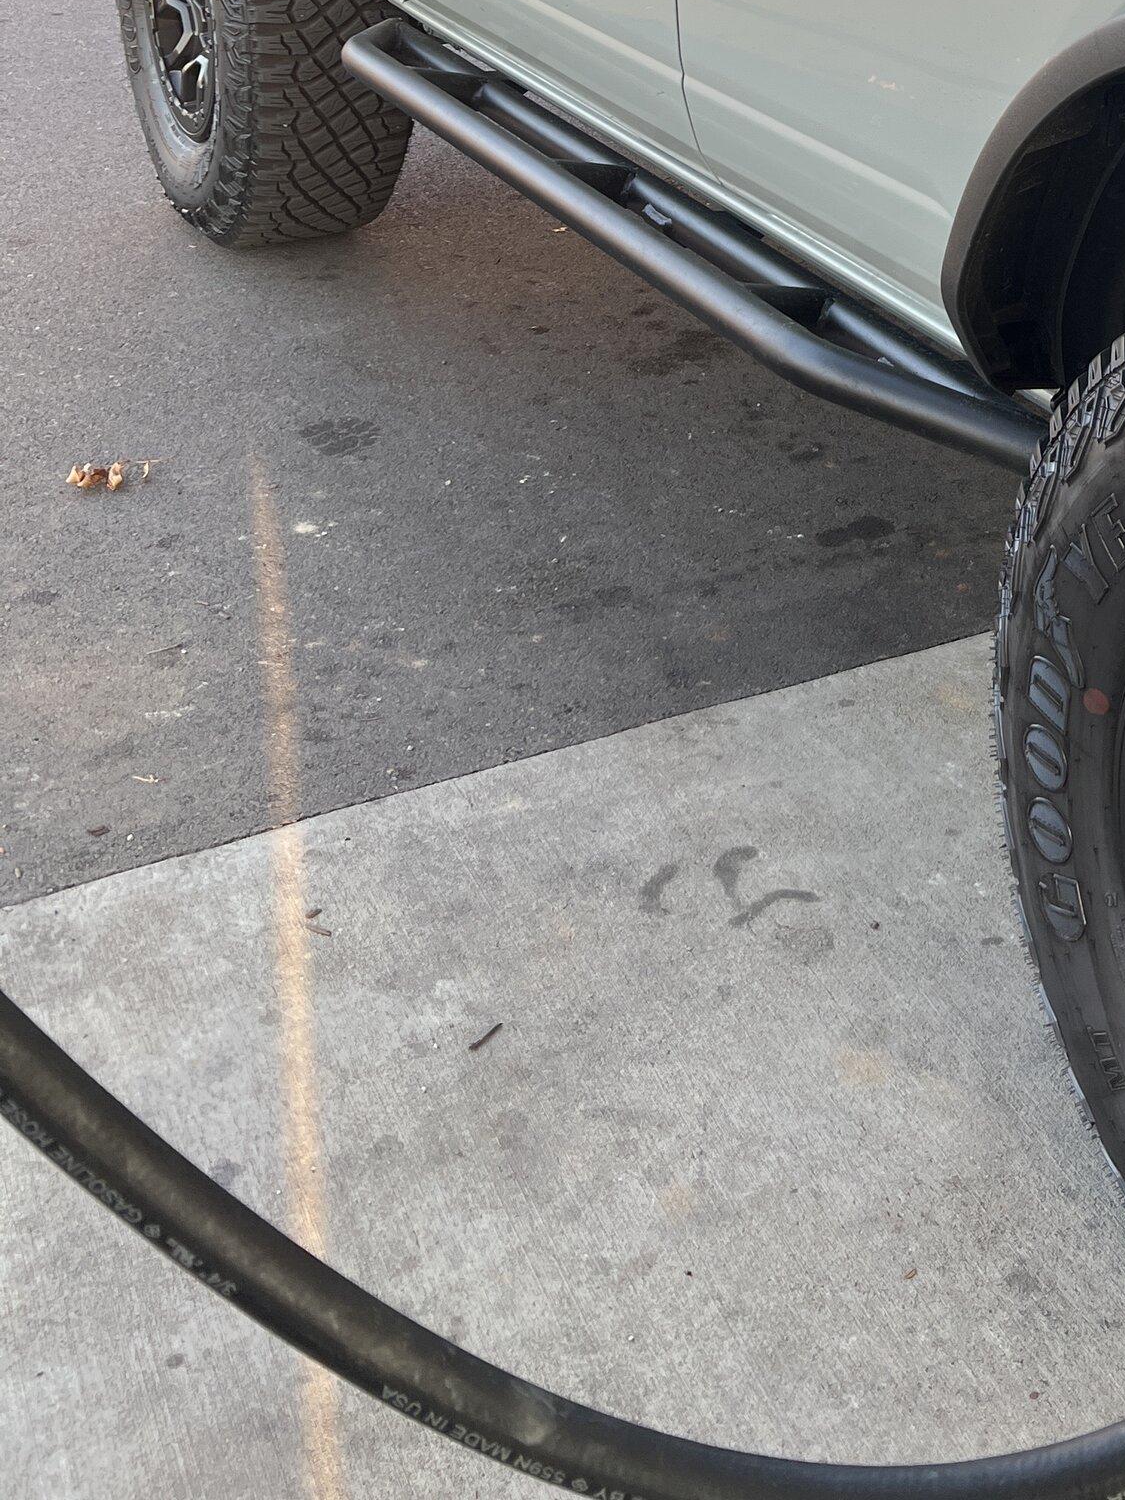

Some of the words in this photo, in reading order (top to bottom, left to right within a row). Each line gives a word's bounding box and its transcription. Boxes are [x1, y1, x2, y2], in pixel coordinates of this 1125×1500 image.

[50, 1145, 142, 1224] GASOLINE
[382, 1384, 422, 1417] USA
[427, 1411, 451, 1433] IN
[450, 1426, 510, 1463] MADE
[514, 1454, 566, 1485] 559N
